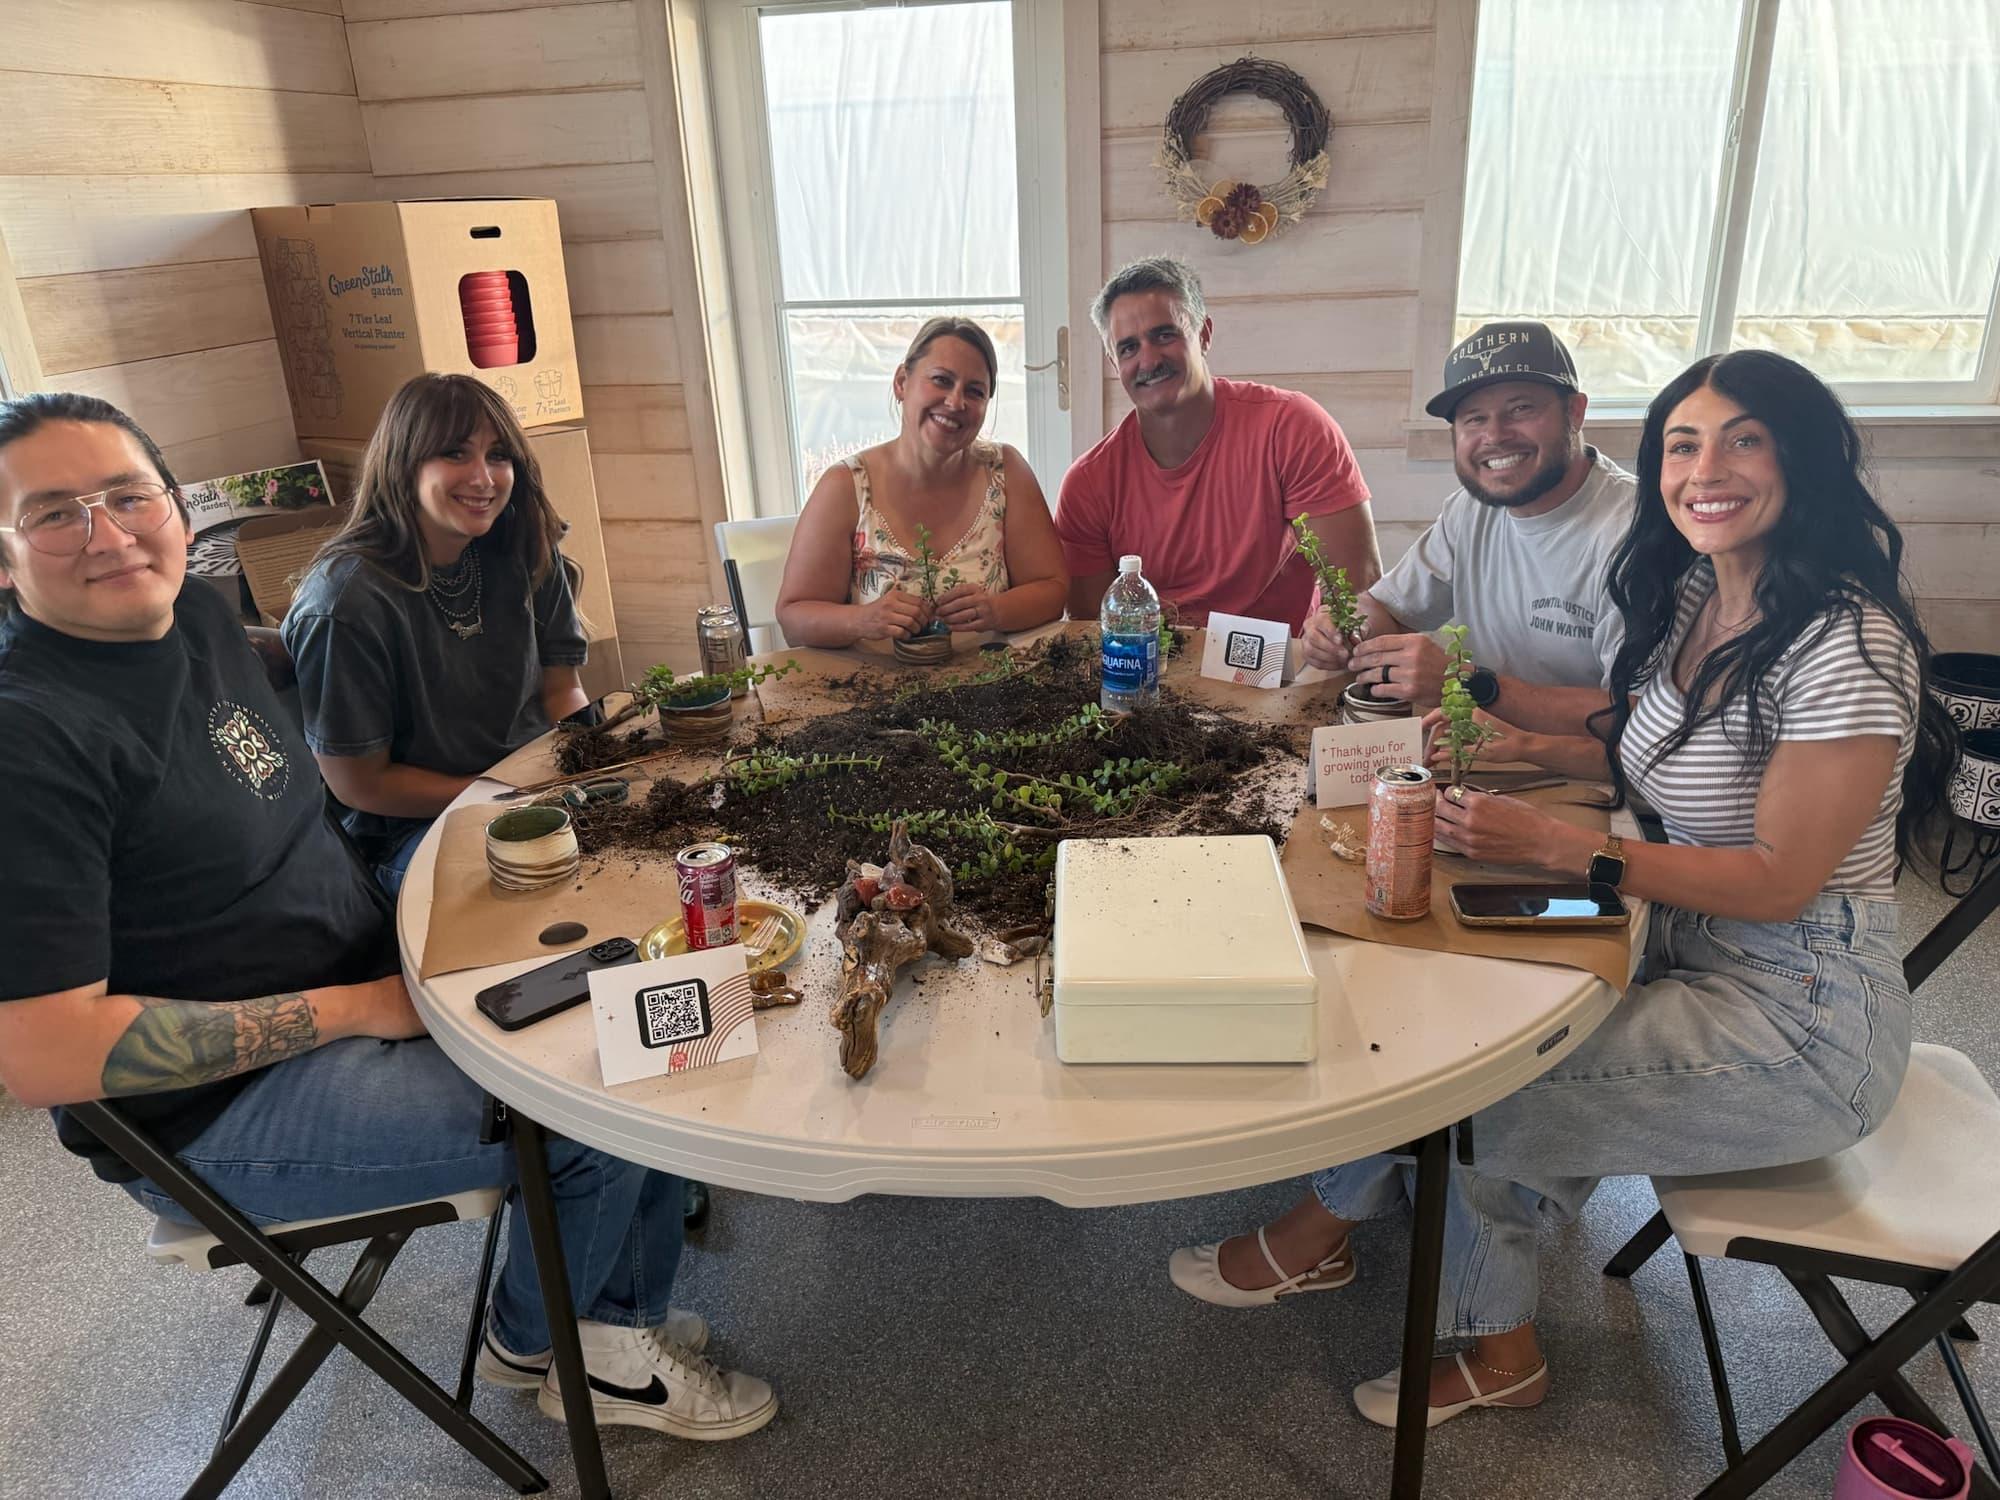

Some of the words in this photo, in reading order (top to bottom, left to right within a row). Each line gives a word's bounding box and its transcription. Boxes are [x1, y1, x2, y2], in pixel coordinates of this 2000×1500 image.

[328, 264, 394, 297] GreenStalk
[371, 285, 403, 298] garden
[348, 313, 354, 324] 7
[355, 313, 373, 324] Tier
[374, 313, 393, 324] Leaf
[341, 328, 373, 339] Vertical
[375, 328, 405, 339] Planter
[1452, 332, 1530, 365] SOUTHERN
[1490, 364, 1509, 374] HAT
[200, 498, 229, 512] garden
[1531, 597, 1562, 610] FRONTIE
[1530, 615, 1554, 632] JOHN
[1556, 622, 1595, 639] WAYNE
[1103, 654, 1142, 670] QUAFINA
[1329, 744, 1363, 758] Thank
[1365, 745, 1385, 758] you
[1388, 741, 1406, 752] for
[1323, 759, 1370, 776] growing
[1372, 756, 1397, 768] with
[1399, 755, 1413, 764] us
[1350, 772, 1375, 784] toda
